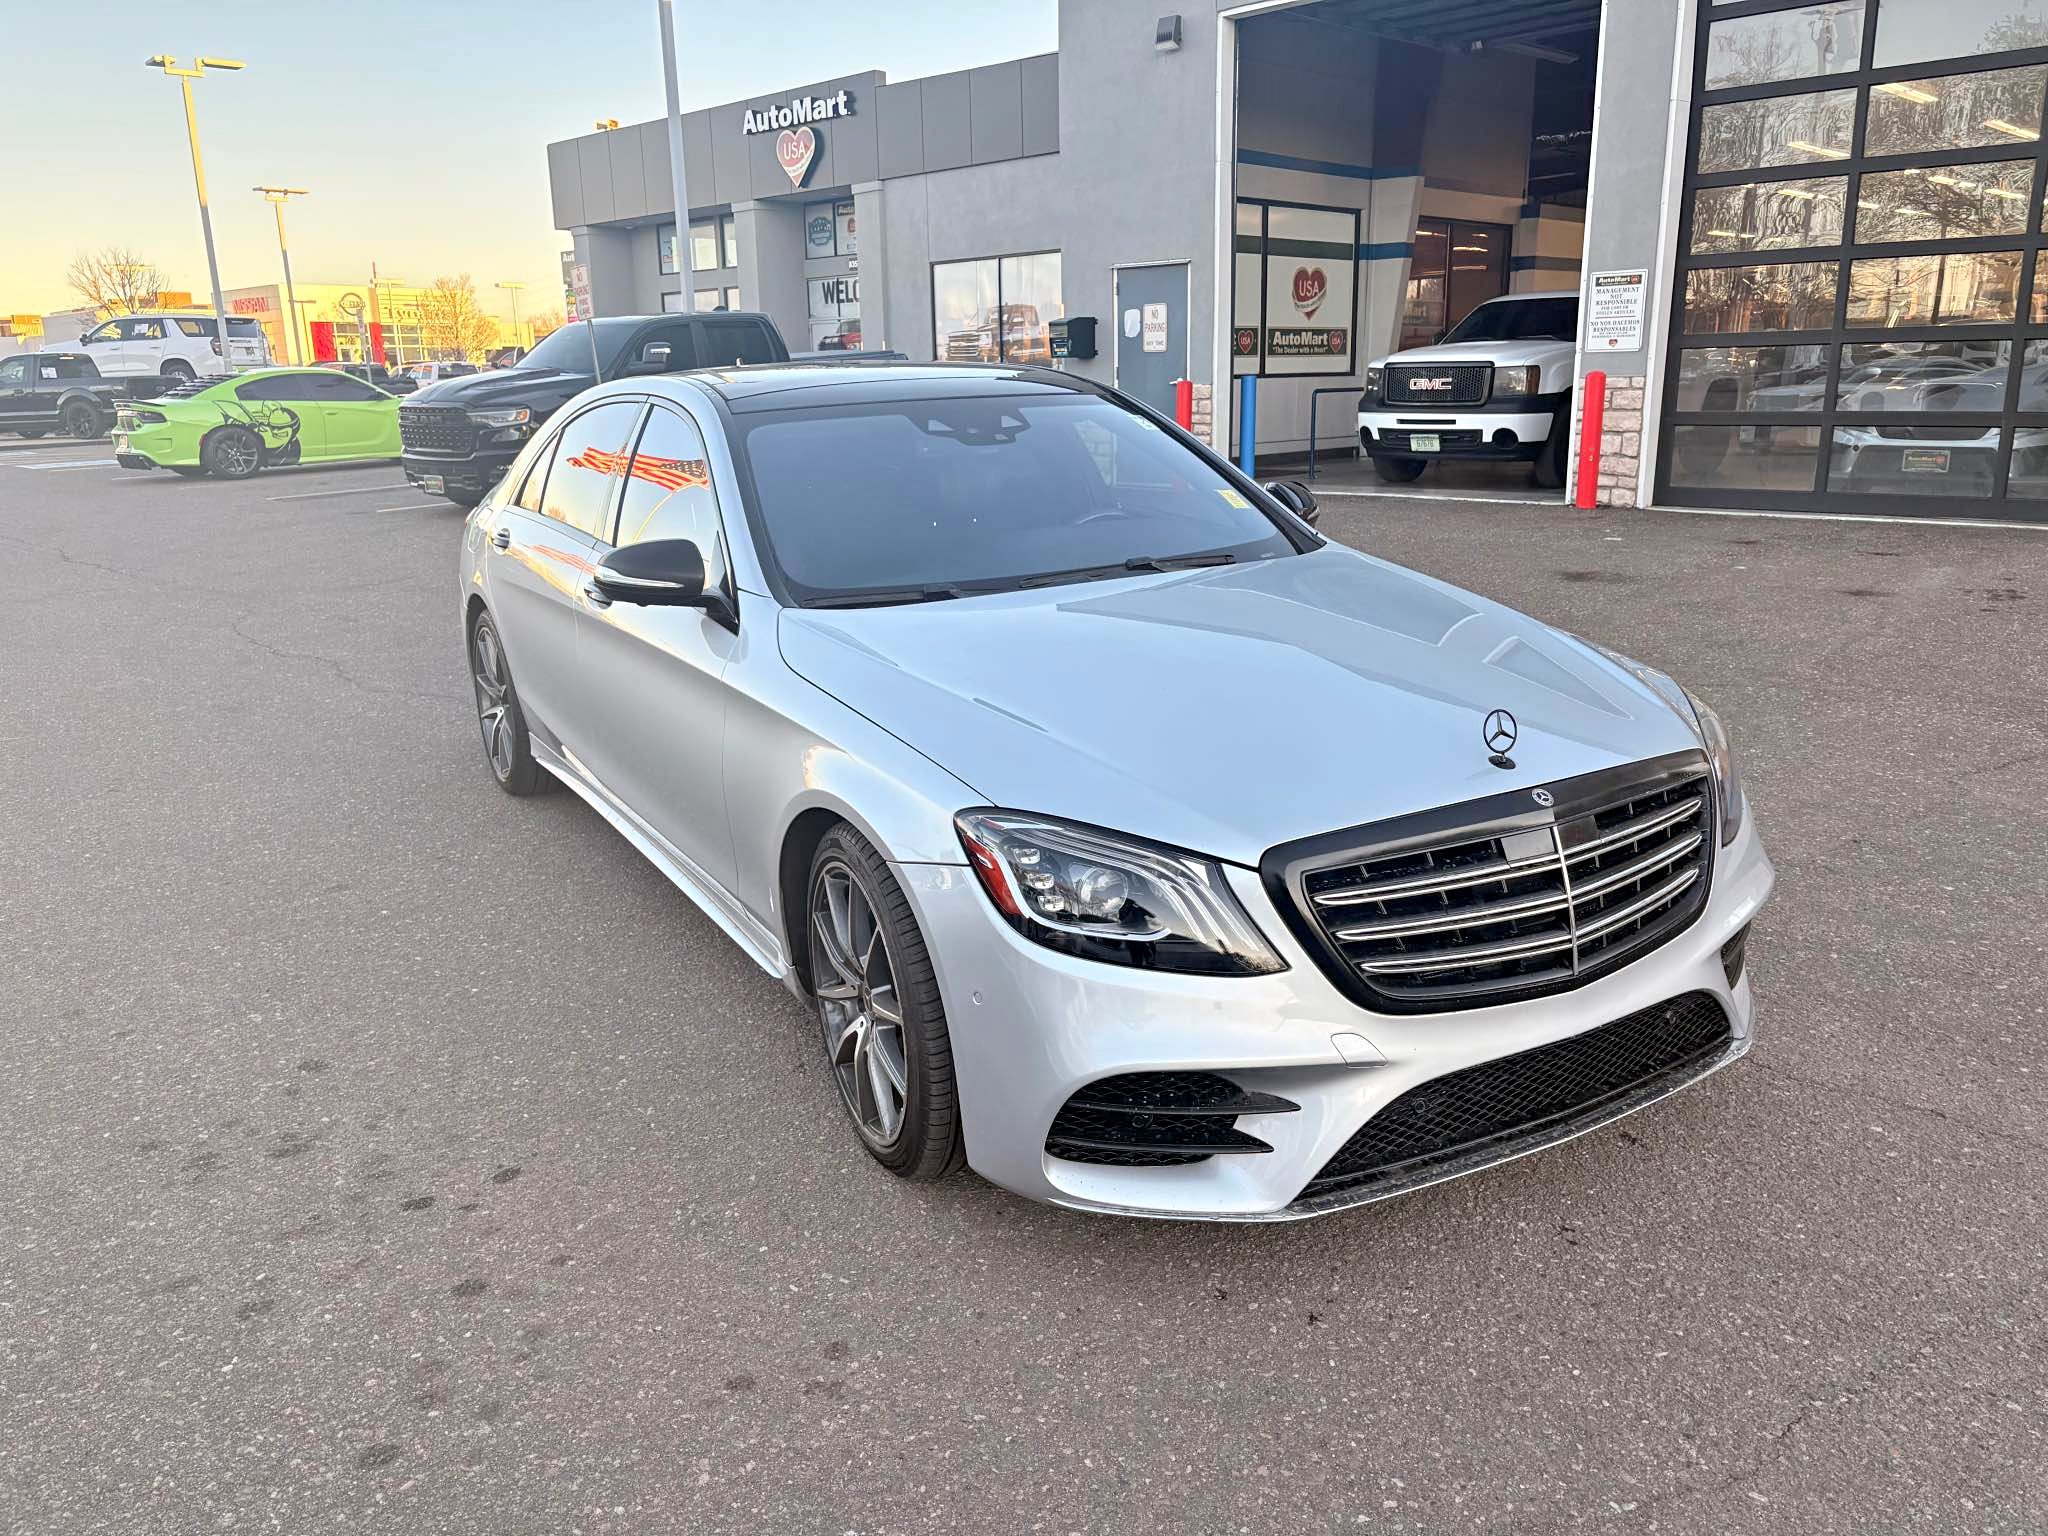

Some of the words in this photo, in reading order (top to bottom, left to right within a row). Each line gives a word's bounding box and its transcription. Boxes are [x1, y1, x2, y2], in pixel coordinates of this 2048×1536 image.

[743, 90, 848, 135] AutoMart
[783, 140, 806, 160] USA
[1300, 280, 1320, 297] USA
[232, 297, 269, 314] NISSAN
[1151, 309, 1159, 320] NO
[1144, 322, 1166, 333] PARKING
[1240, 336, 1250, 344] USA
[1272, 331, 1328, 346] AutoMart
[1409, 378, 1452, 390] GMC
